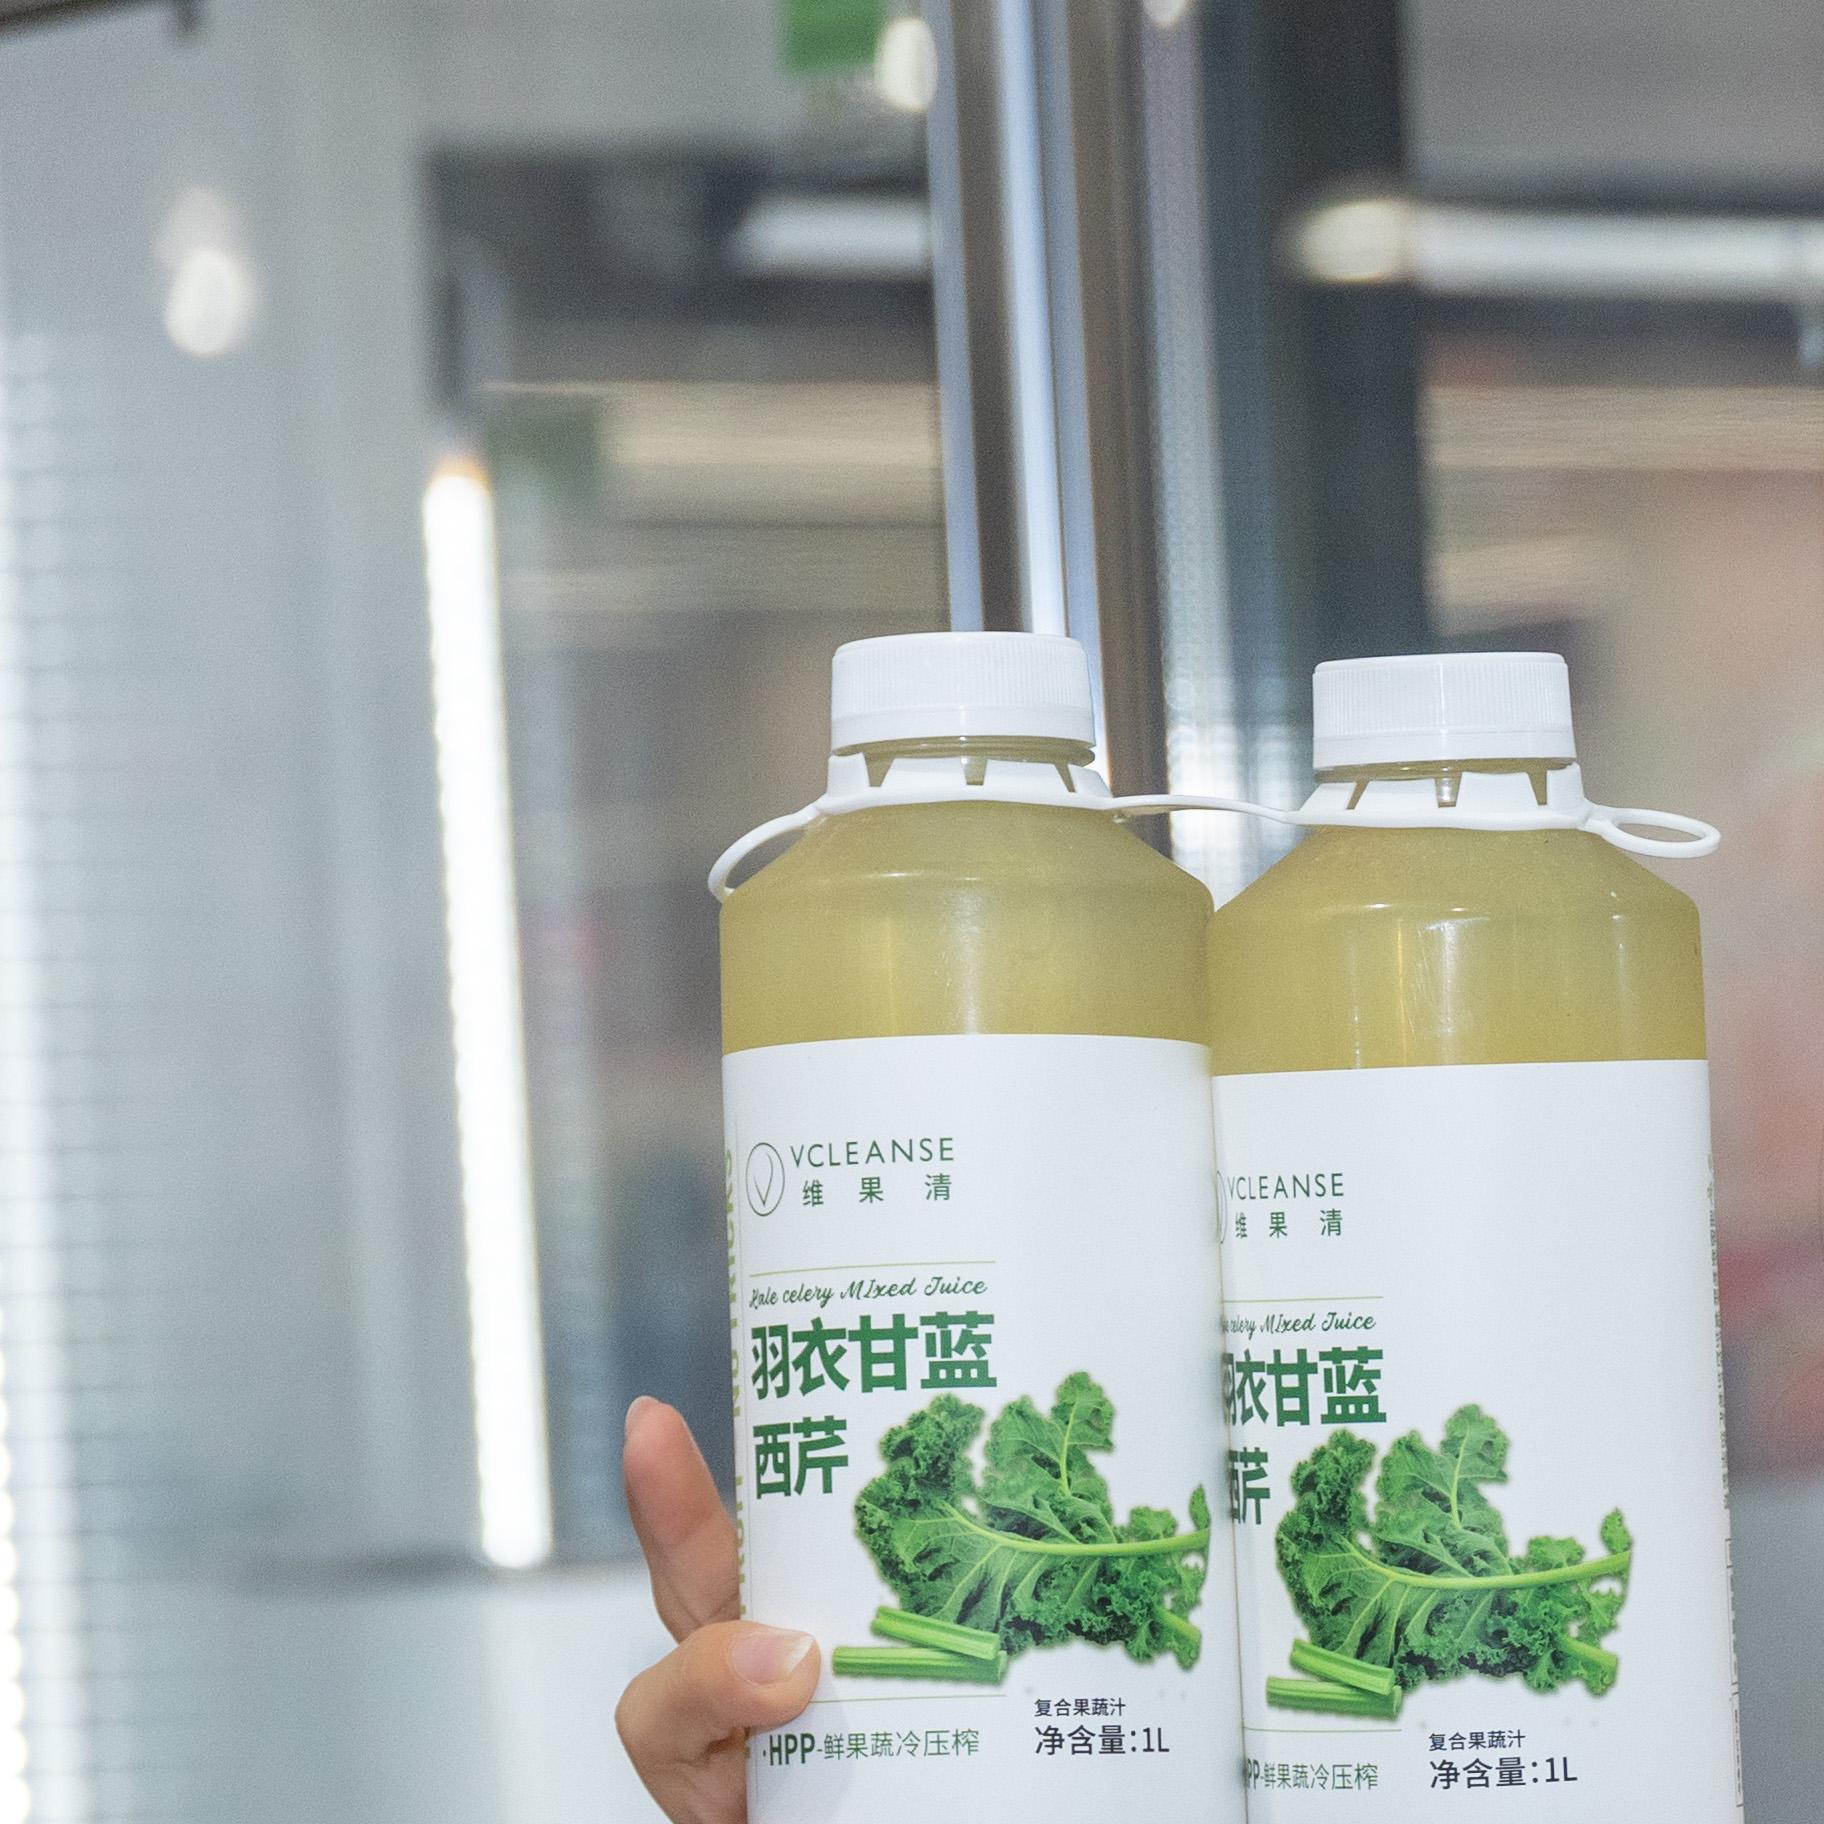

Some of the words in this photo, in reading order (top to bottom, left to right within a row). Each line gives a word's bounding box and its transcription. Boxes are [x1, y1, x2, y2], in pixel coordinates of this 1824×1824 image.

[789, 1136, 955, 1169] VCLEANSE
[1226, 1172, 1344, 1201] VCLEANSE
[782, 1283, 834, 1308] celery
[924, 1276, 987, 1297] Juice
[1322, 1311, 1377, 1332] Juice
[751, 1310, 997, 1400] 羽衣甘蓝
[753, 1414, 848, 1500] 西芹
[1034, 1697, 1126, 1718] 复合果蔬汁
[1034, 1723, 1170, 1756] 净含量:1L
[1428, 1729, 1526, 1752] 复合果蔬汁
[1429, 1756, 1578, 1791] 净含量:1L
